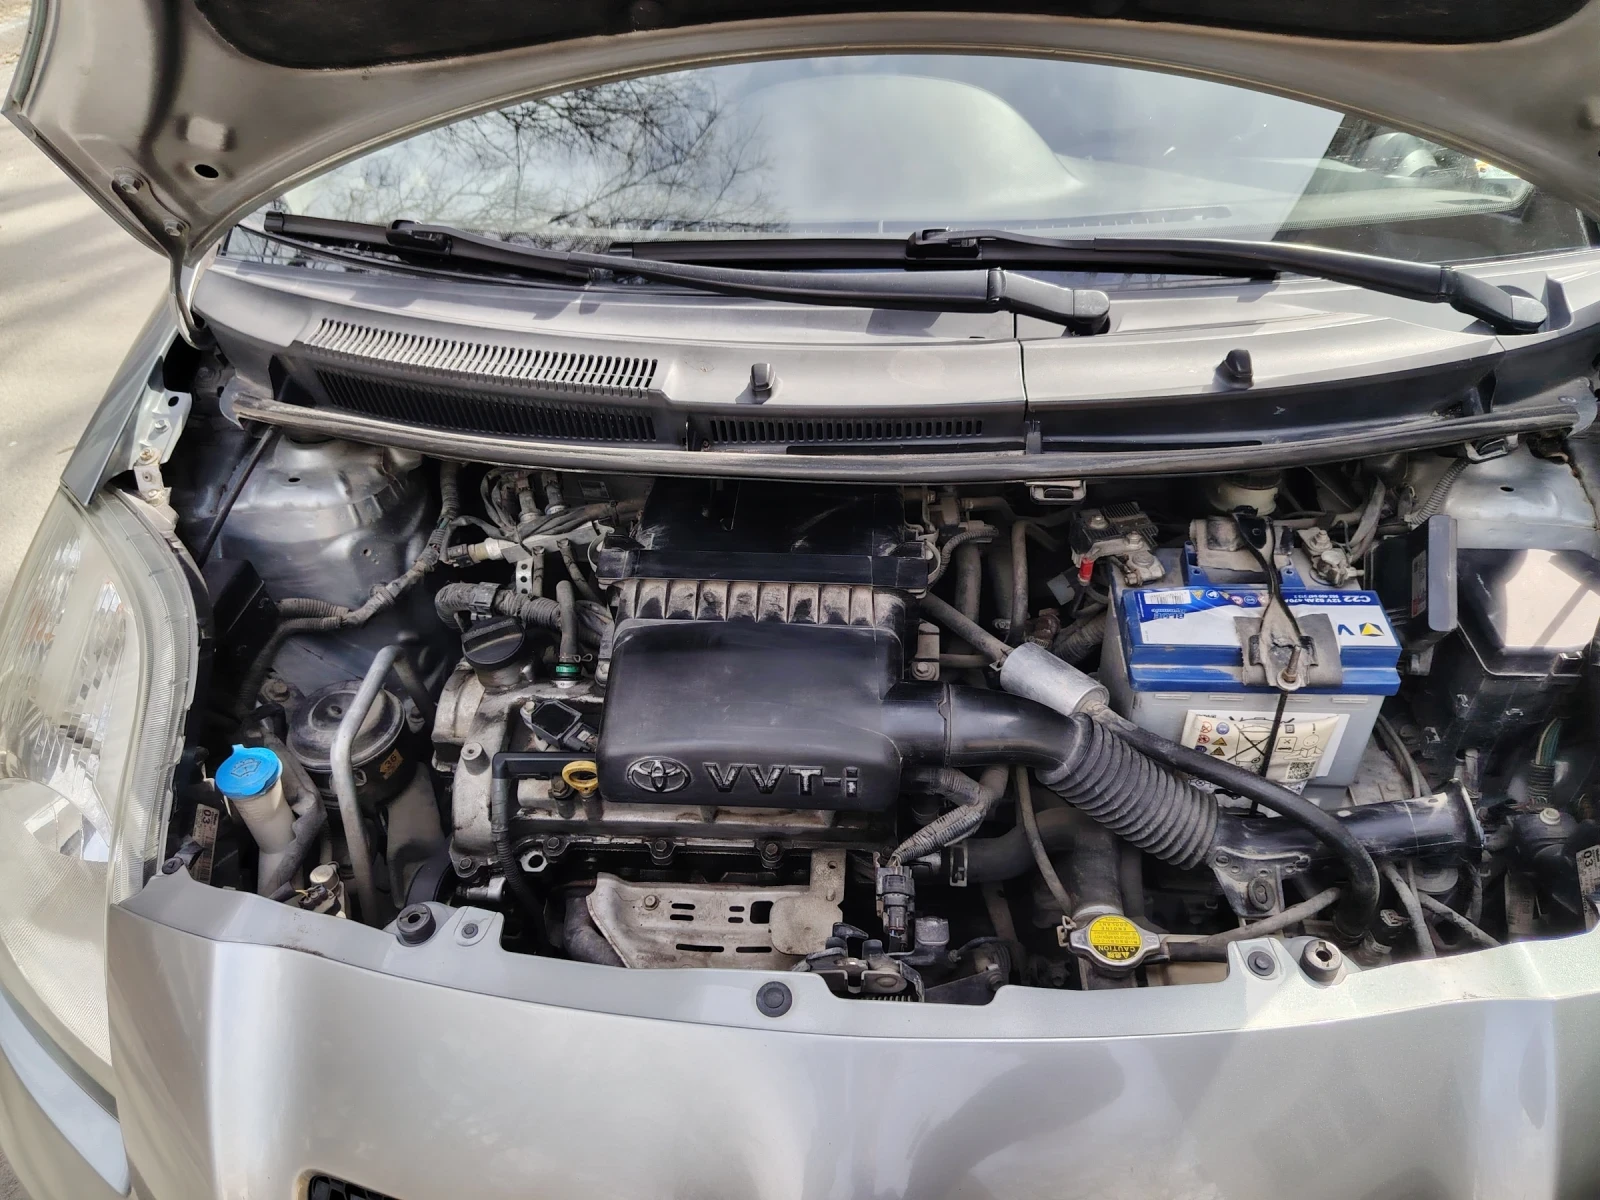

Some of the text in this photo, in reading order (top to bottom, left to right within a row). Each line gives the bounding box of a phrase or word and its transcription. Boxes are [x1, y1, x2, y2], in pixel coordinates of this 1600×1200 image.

[1342, 595, 1371, 603] C22
[1153, 612, 1185, 620] BLUE
[702, 762, 860, 797] VVT-i
[203, 809, 212, 824] 03
[1584, 850, 1593, 867] 03
